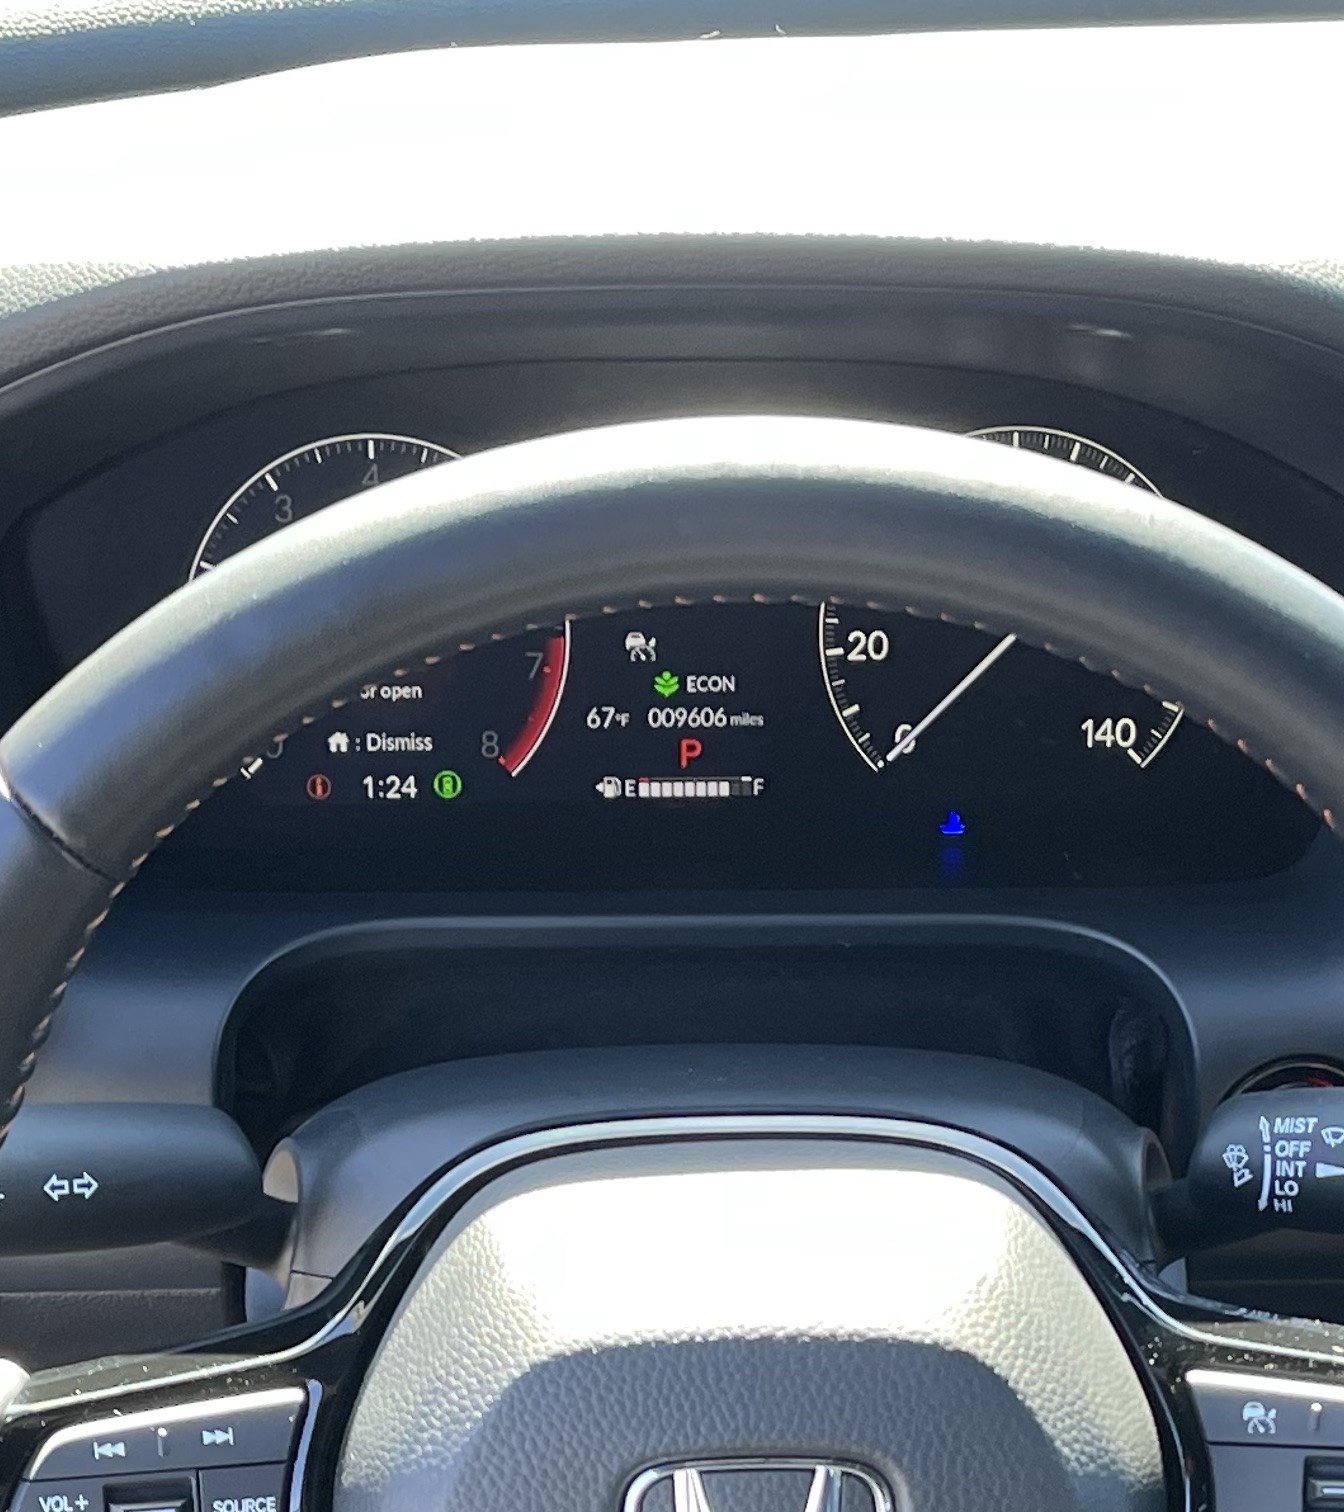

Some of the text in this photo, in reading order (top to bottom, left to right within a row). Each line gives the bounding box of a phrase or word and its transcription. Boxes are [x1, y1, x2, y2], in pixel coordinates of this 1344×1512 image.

[361, 462, 379, 485] 4
[274, 494, 293, 523] 3
[846, 629, 890, 662] 20
[524, 652, 544, 681] 7
[379, 685, 423, 702] open
[685, 674, 736, 694] ECON
[647, 706, 728, 729] 009606
[729, 711, 765, 728] miles
[366, 732, 433, 752] Dismiss
[1080, 716, 1137, 749] 140
[480, 730, 500, 759] 8
[678, 736, 703, 769] P
[361, 774, 419, 800] 1:24
[624, 778, 765, 798] E F
[1273, 1116, 1318, 1134] MIST
[1274, 1140, 1312, 1158] OFF
[1275, 1160, 1306, 1178] INT
[1273, 1180, 1299, 1197] LO
[1273, 1198, 1294, 1213] HI
